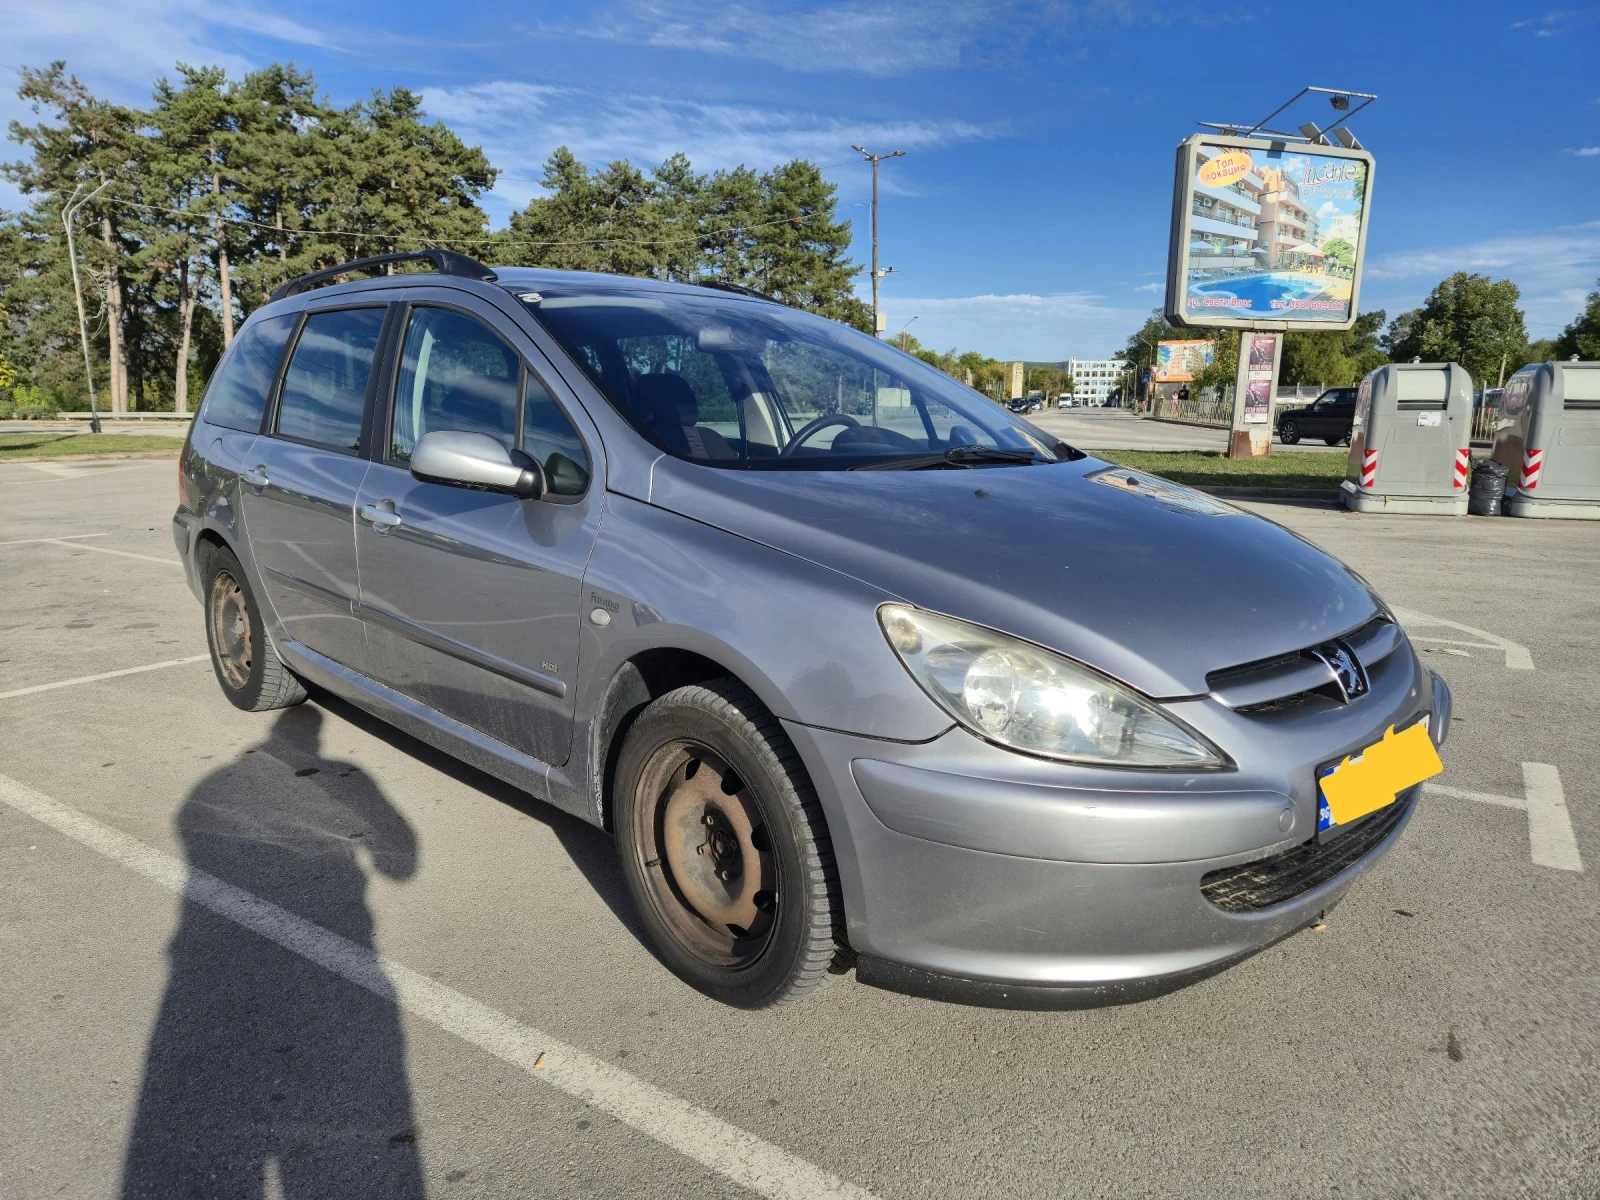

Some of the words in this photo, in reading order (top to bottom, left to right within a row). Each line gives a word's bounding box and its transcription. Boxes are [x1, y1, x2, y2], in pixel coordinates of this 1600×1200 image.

[1215, 159, 1233, 169] Топ
[1205, 165, 1246, 181] локация
[1203, 297, 1228, 307] Свети
